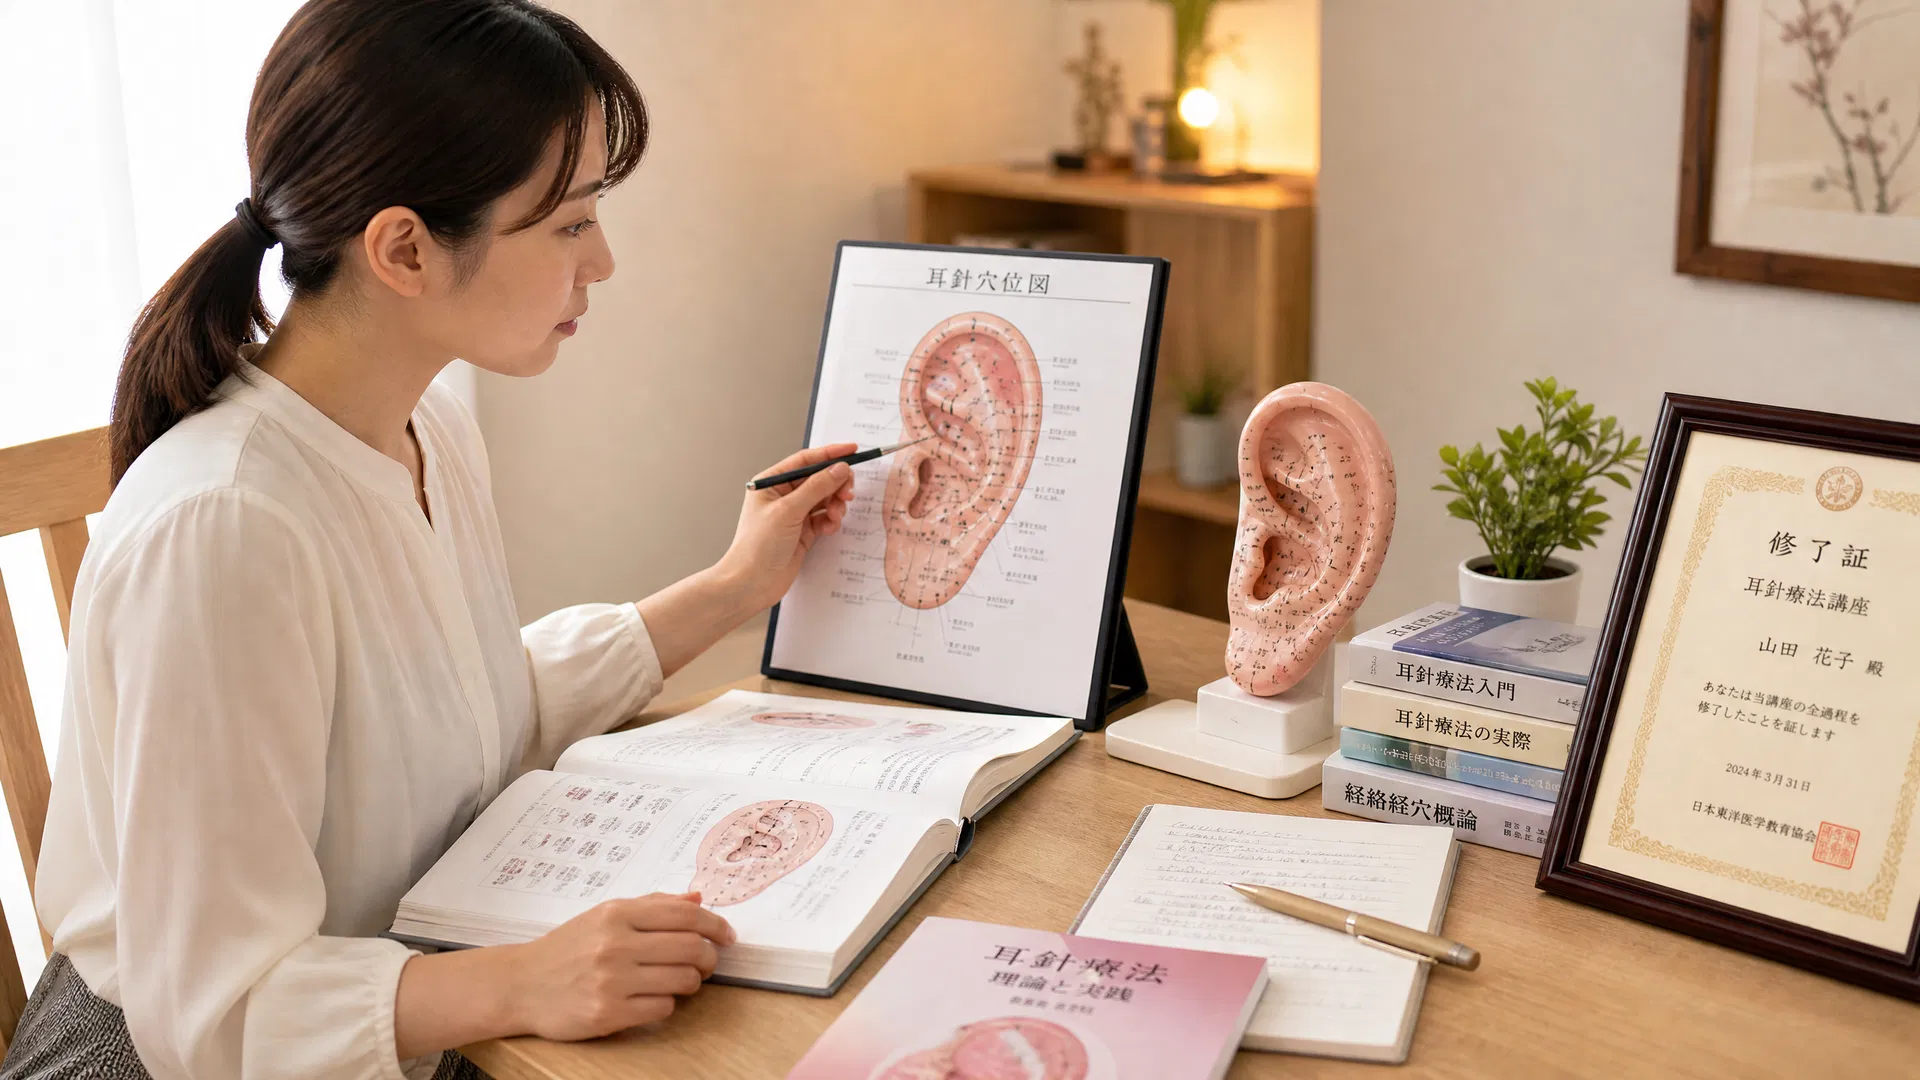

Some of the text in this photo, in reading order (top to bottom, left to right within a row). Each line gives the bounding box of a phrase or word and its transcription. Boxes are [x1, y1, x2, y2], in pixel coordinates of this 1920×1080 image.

[925, 266, 1051, 295] 耳針穴位図
[1769, 531, 1870, 570] 修了証
[1744, 576, 1871, 617] 耳針療法講座
[1759, 637, 1884, 678] 山田 花子 殿
[1396, 661, 1516, 702] 耳針療法入門
[1697, 700, 1837, 742] 修了したことを証します
[1702, 680, 1861, 726] あなたは当講座の全過程を
[1395, 708, 1532, 751] 耳針療法の実際
[1344, 782, 1478, 832] 経絡経穴概論
[1692, 800, 1817, 843] 日本東洋医学教育協会
[983, 944, 1170, 985] 耳針療法
[988, 970, 1134, 1004] 理論と実践
